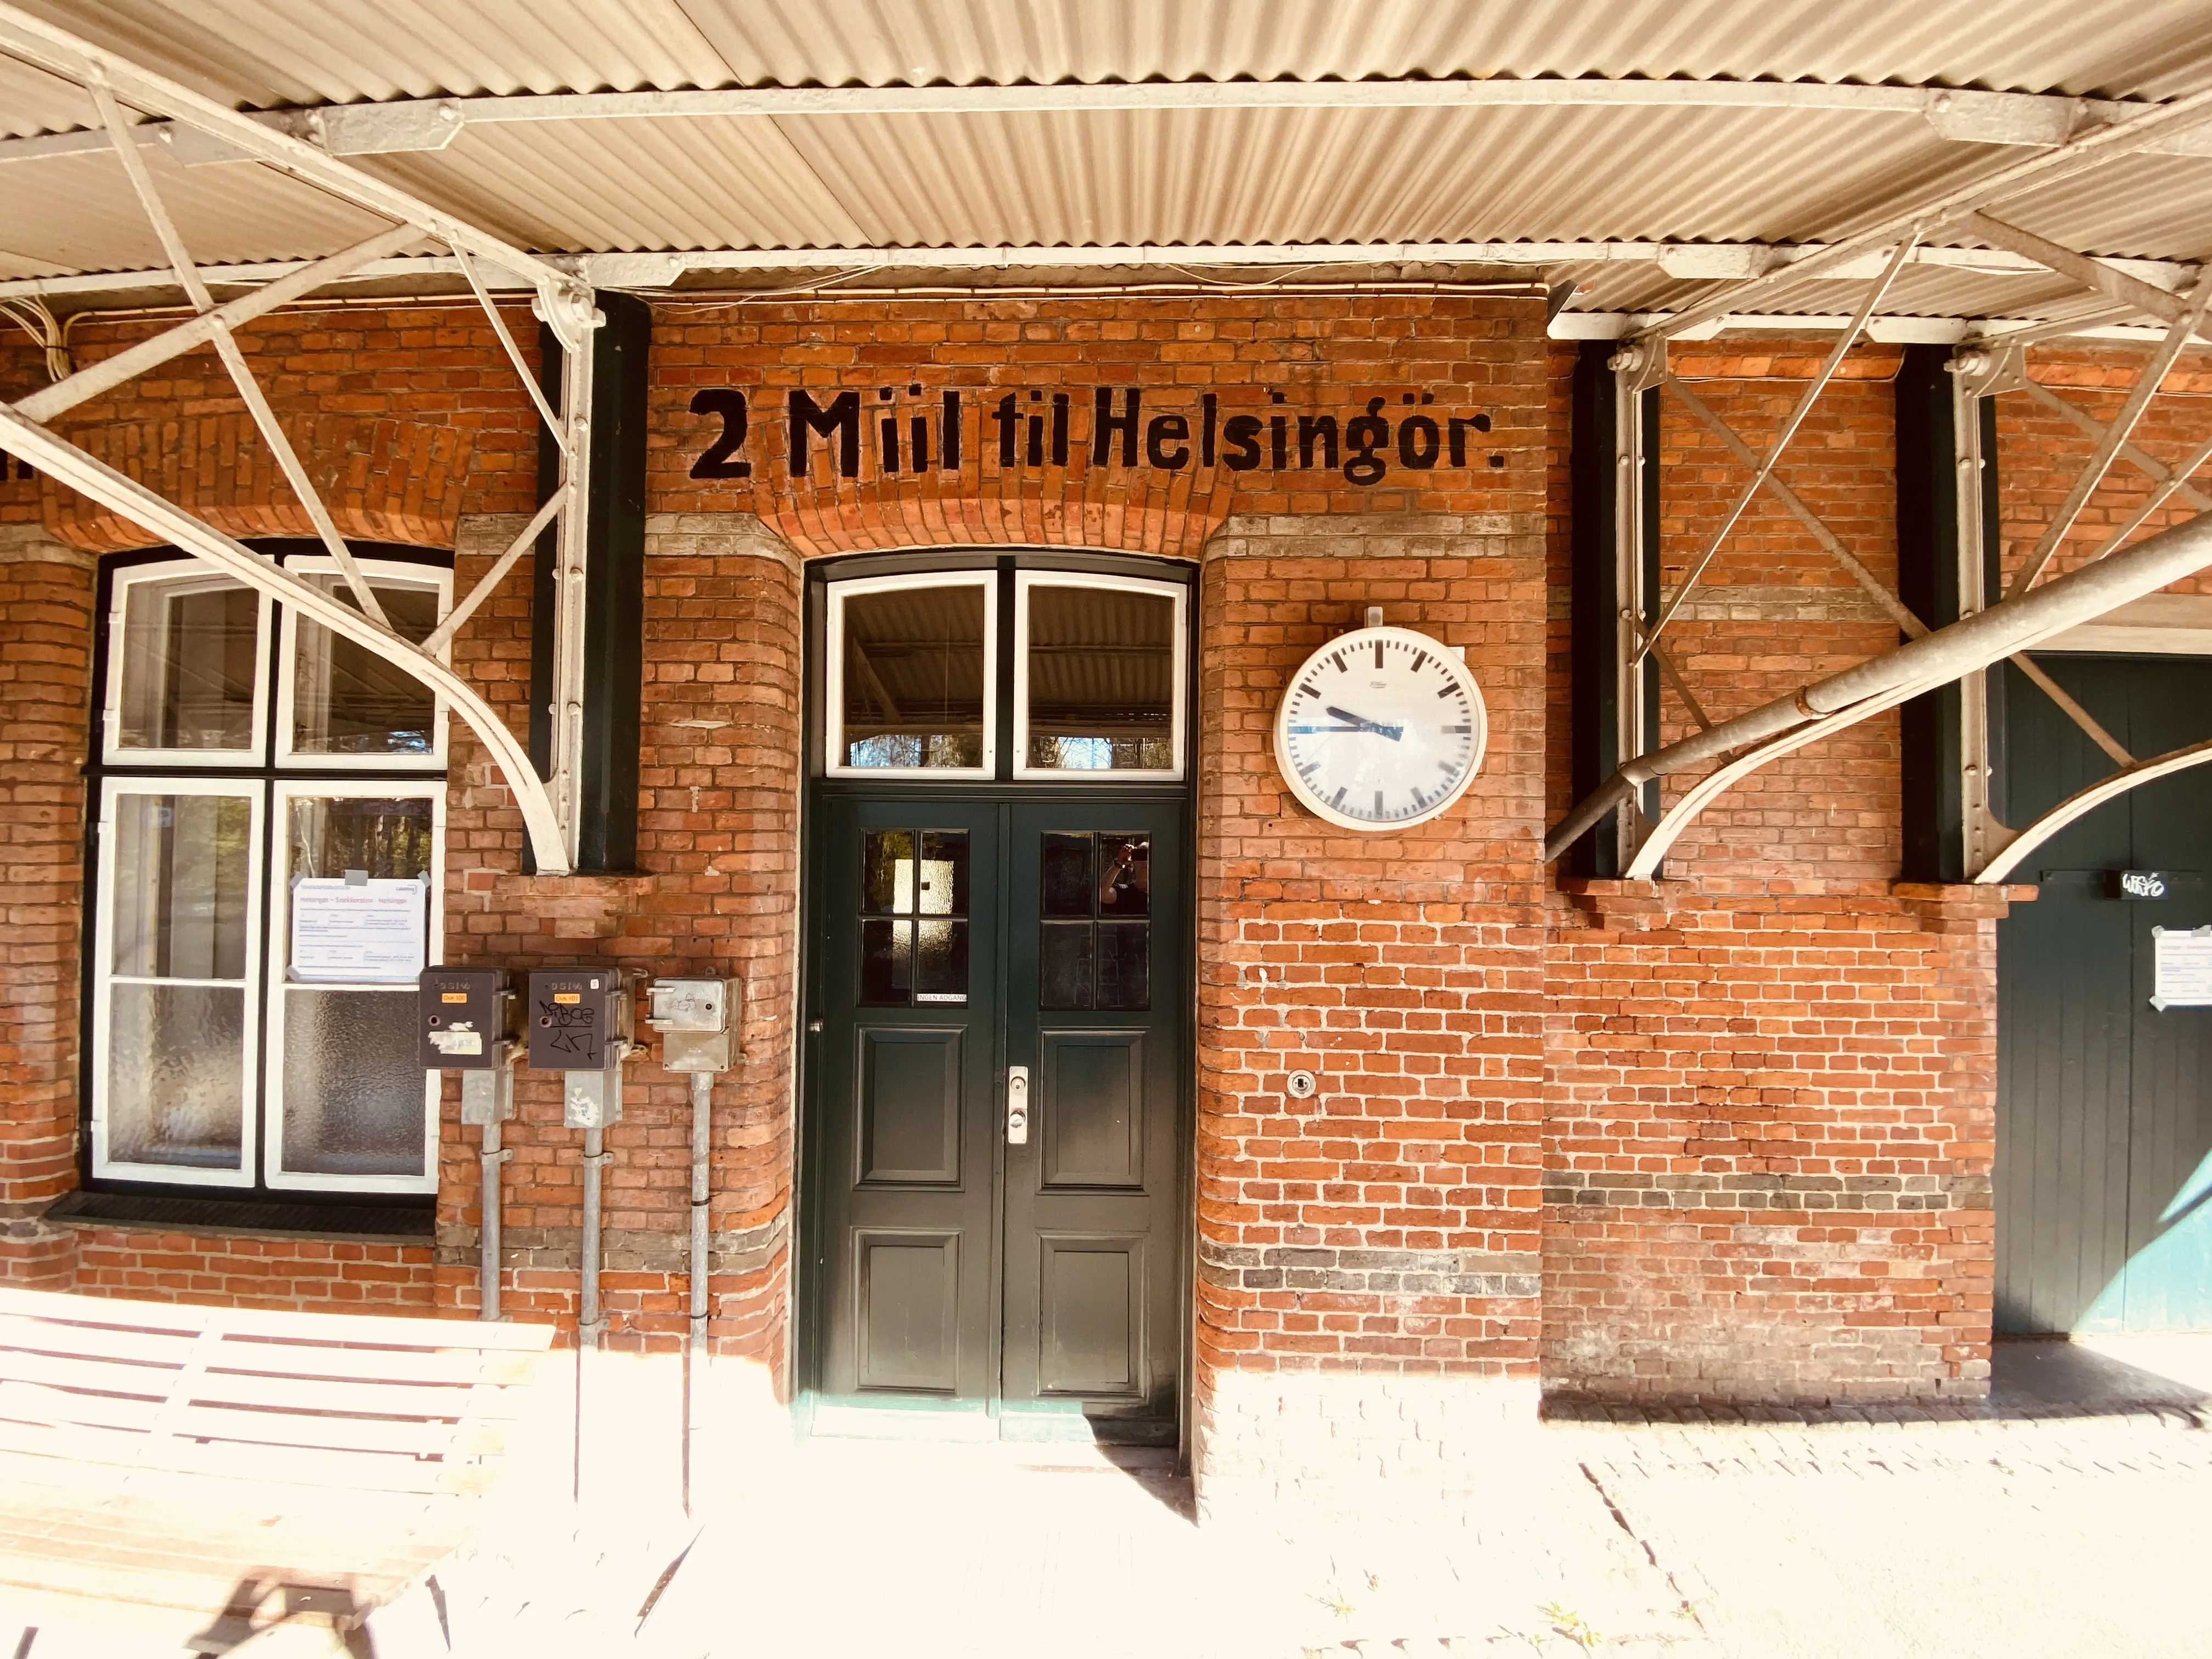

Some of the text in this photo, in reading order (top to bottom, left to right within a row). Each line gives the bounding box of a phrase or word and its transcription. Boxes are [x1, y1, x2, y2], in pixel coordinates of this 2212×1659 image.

[689, 384, 1504, 486] 2 Miil til Helsingör.
